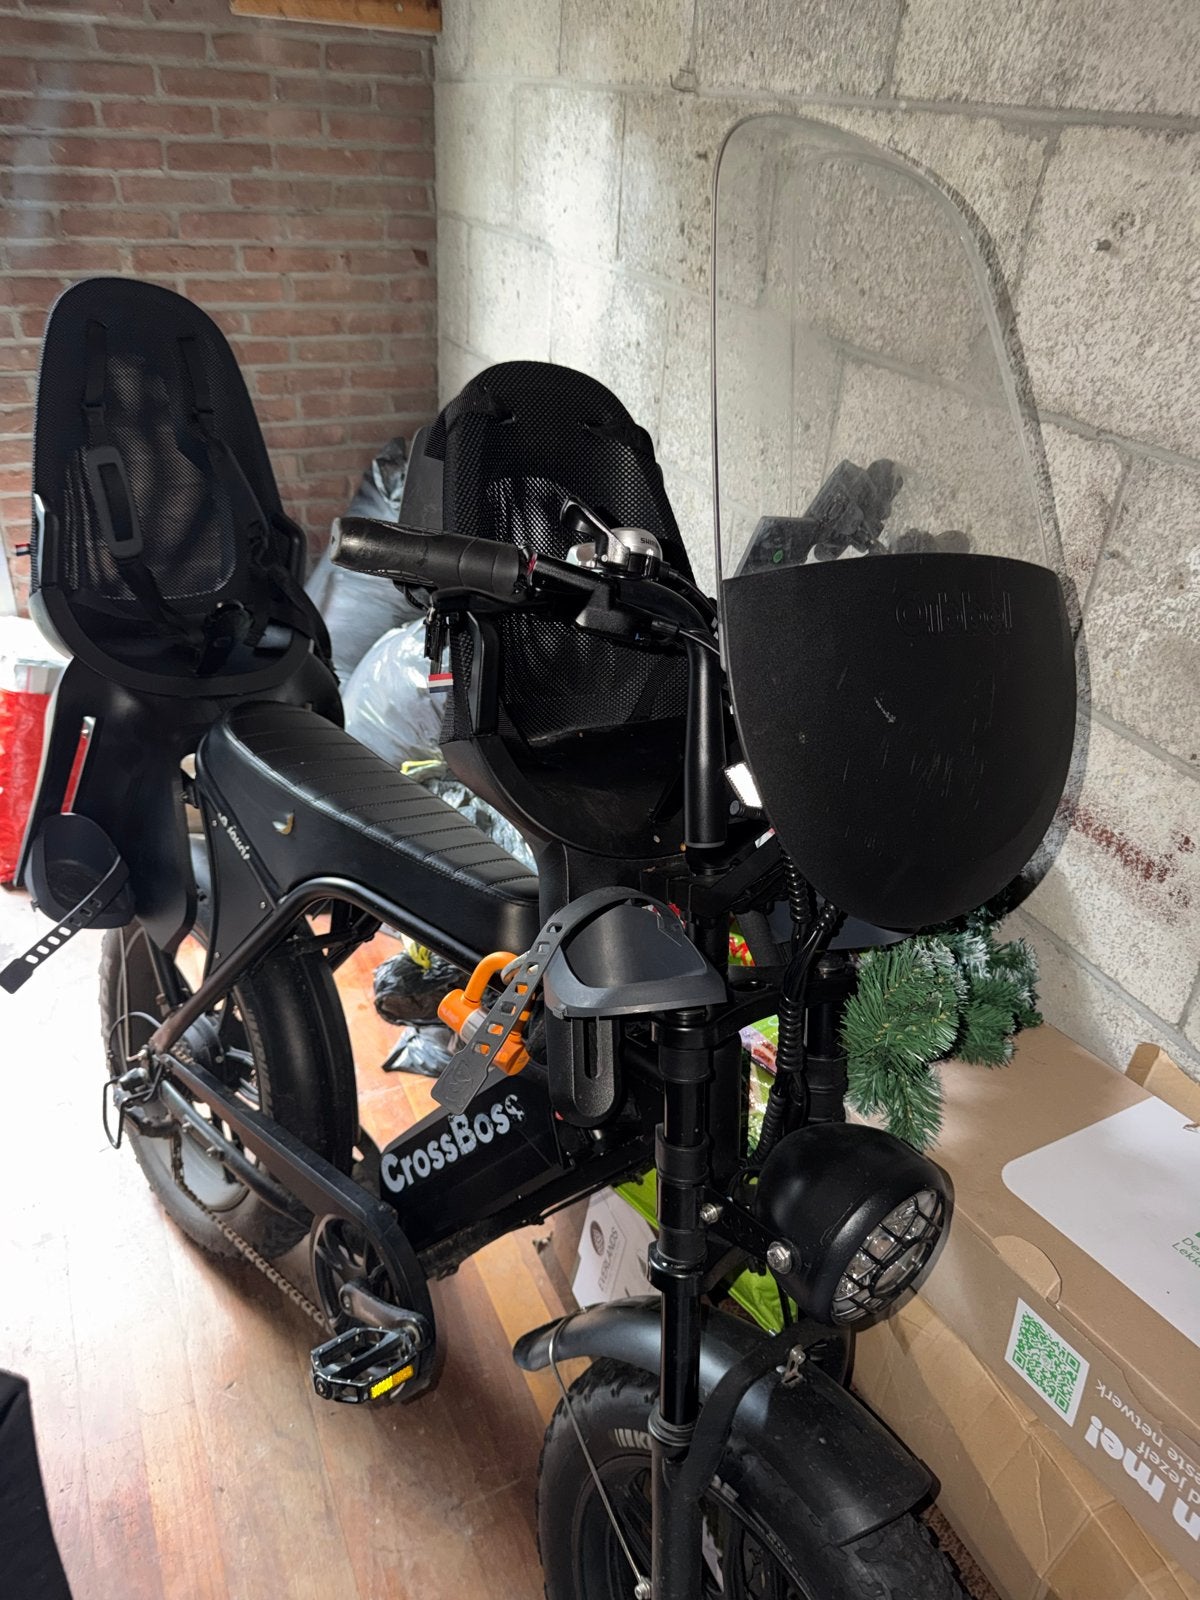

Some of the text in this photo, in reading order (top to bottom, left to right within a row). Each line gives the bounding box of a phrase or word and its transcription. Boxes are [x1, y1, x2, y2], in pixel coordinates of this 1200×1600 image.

[1172, 1242, 1200, 1267] Lekk
[1096, 1378, 1164, 1448] netwerk
[1084, 1415, 1167, 1504] me!
[1136, 1441, 1188, 1493] jezelf
